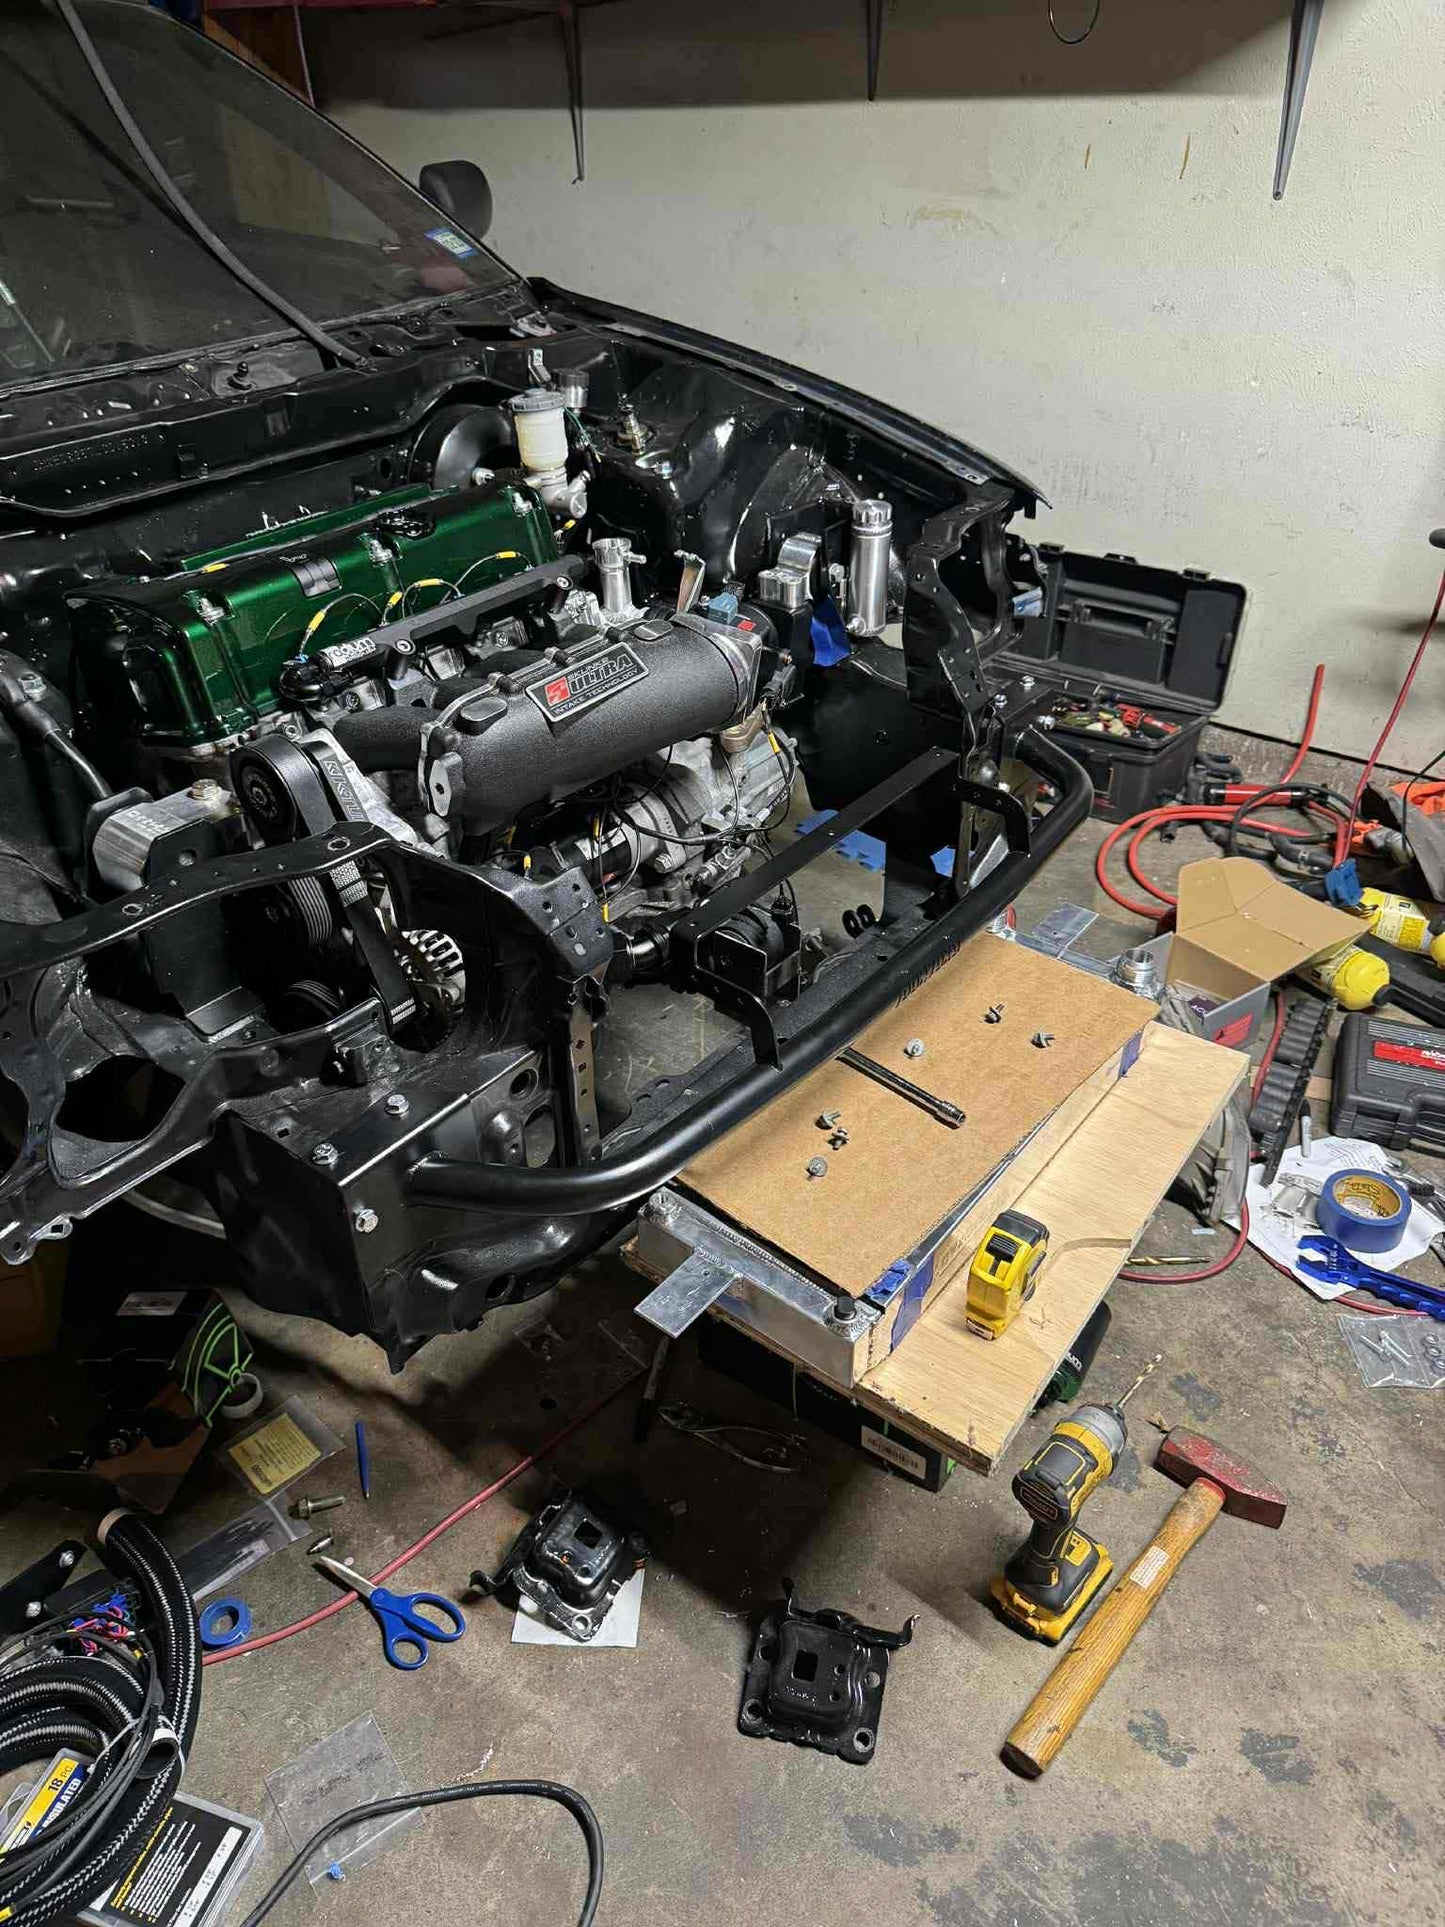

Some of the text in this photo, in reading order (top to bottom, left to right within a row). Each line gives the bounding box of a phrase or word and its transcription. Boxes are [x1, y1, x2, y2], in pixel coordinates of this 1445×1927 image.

[553, 668, 639, 715] INTAKE TECHNOLOGY
[568, 653, 634, 695] ULTRA
[48, 1778, 64, 1793] 18
